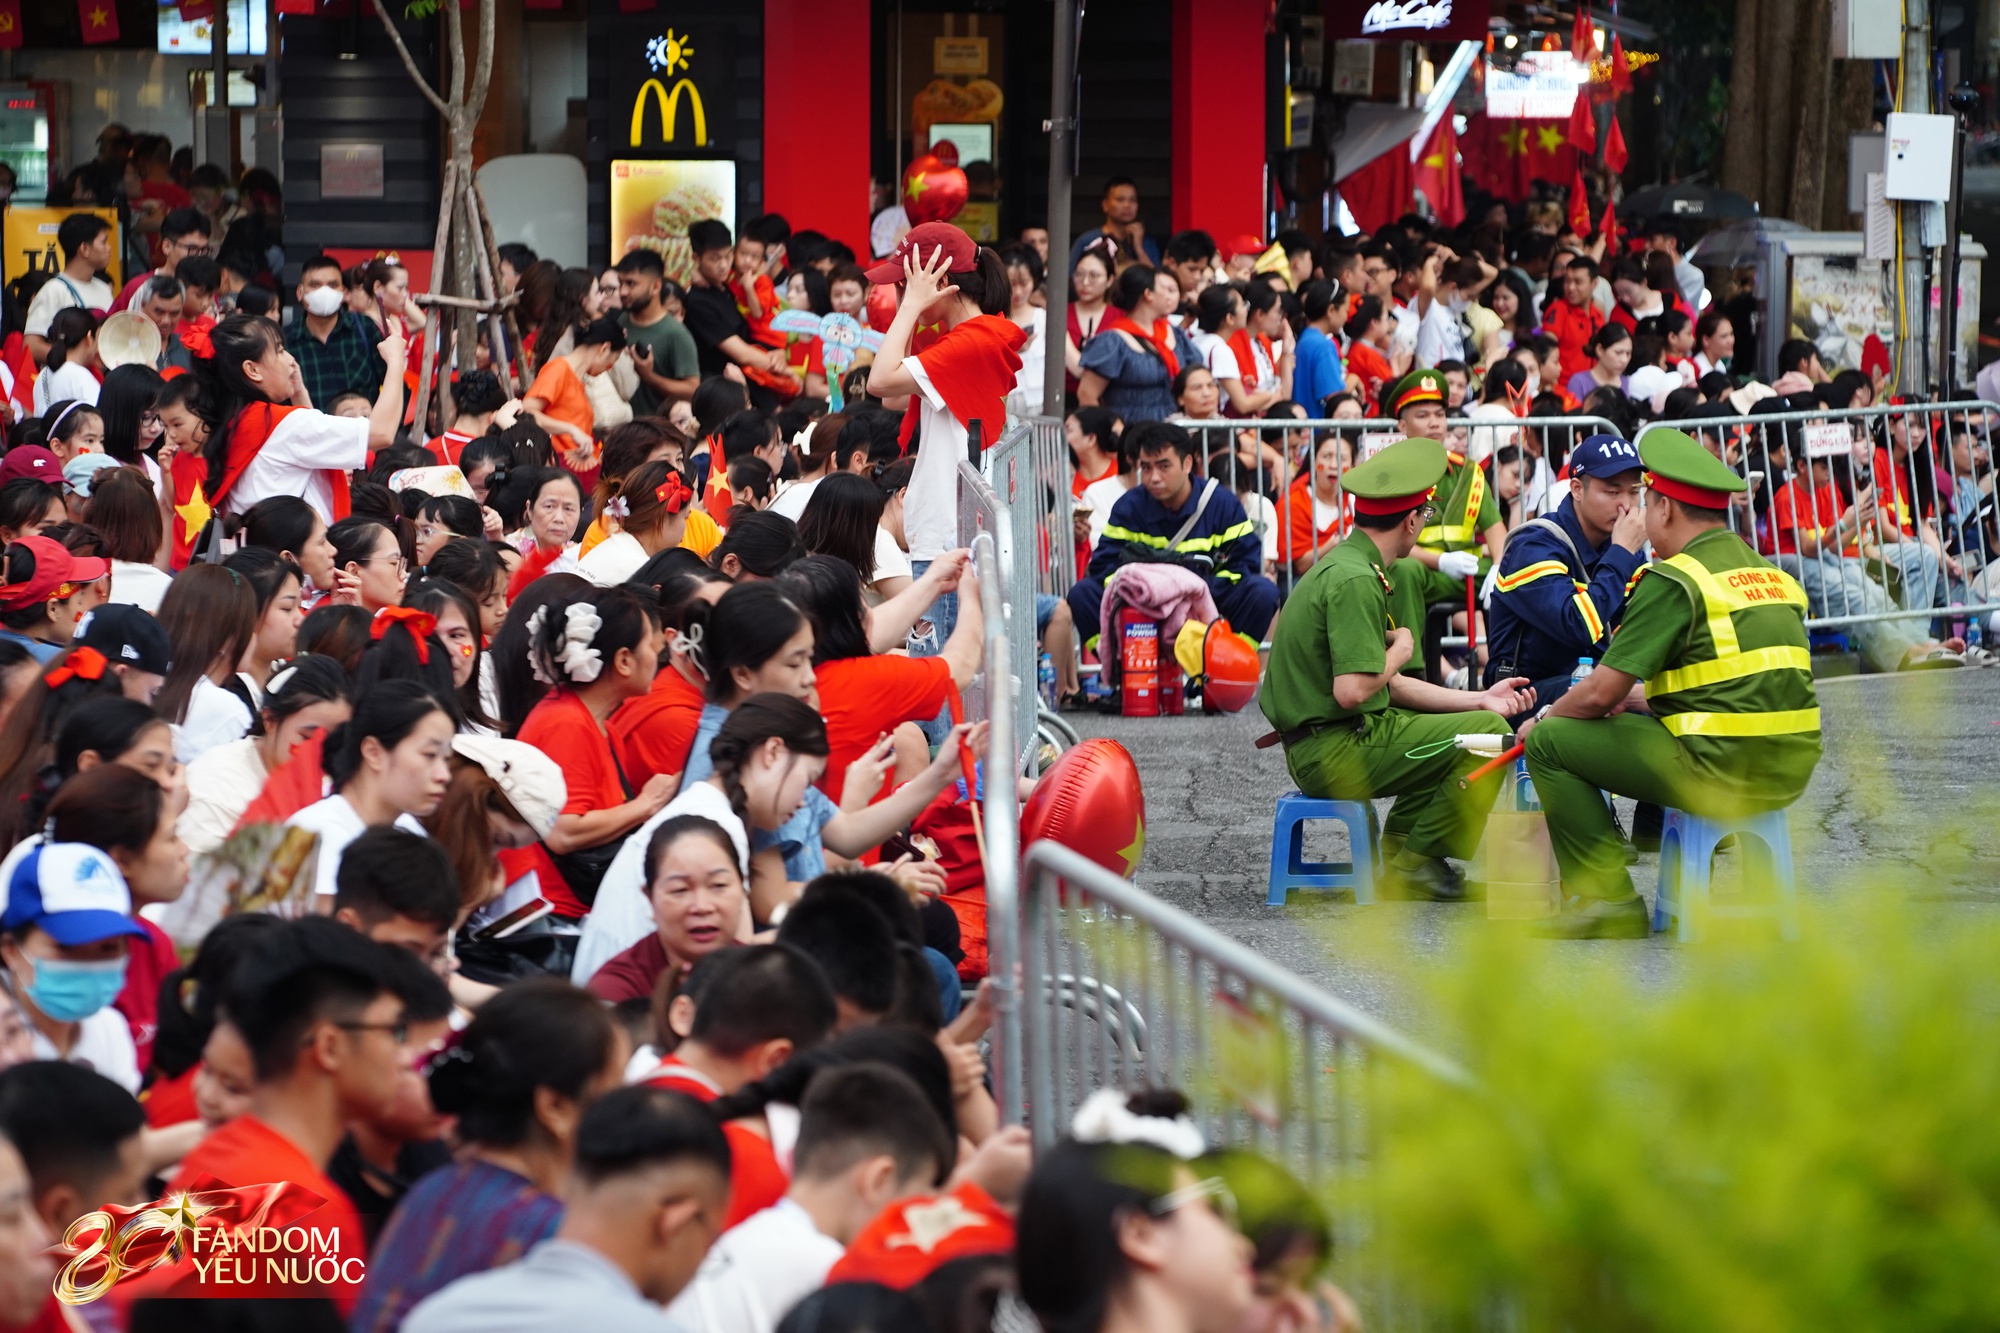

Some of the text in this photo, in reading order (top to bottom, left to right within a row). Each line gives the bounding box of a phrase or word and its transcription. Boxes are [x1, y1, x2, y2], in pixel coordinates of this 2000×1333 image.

[1598, 440, 1636, 458] 114
[1727, 571, 1783, 588] CÔNG AN
[1743, 585, 1788, 602] HÀ NỘI
